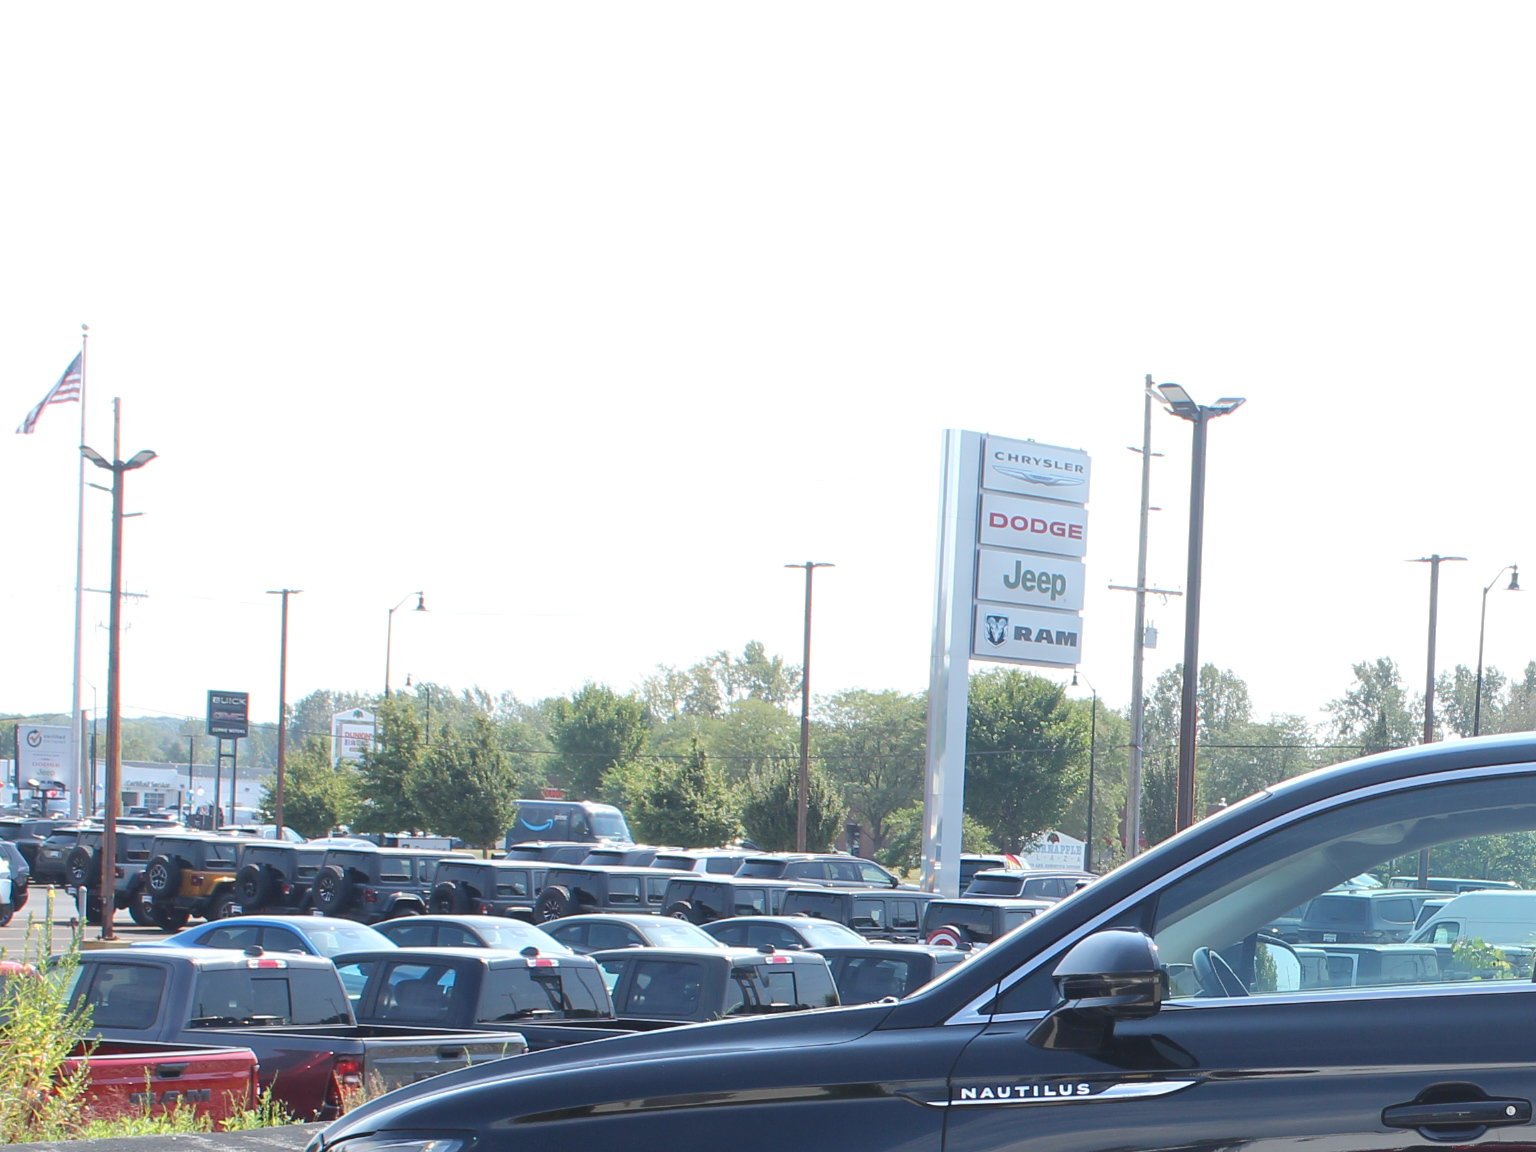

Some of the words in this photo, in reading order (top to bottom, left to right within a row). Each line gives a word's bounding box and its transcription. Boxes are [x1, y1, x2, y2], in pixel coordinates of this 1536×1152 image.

[994, 451, 1084, 474] CHRYSLER
[989, 512, 1083, 540] DODGE
[1003, 560, 1067, 601] Jeep
[1013, 625, 1077, 647] RAM
[212, 696, 247, 705] BUICK
[129, 1088, 212, 1105] RAM
[961, 1083, 1091, 1099] NAUTILUS
